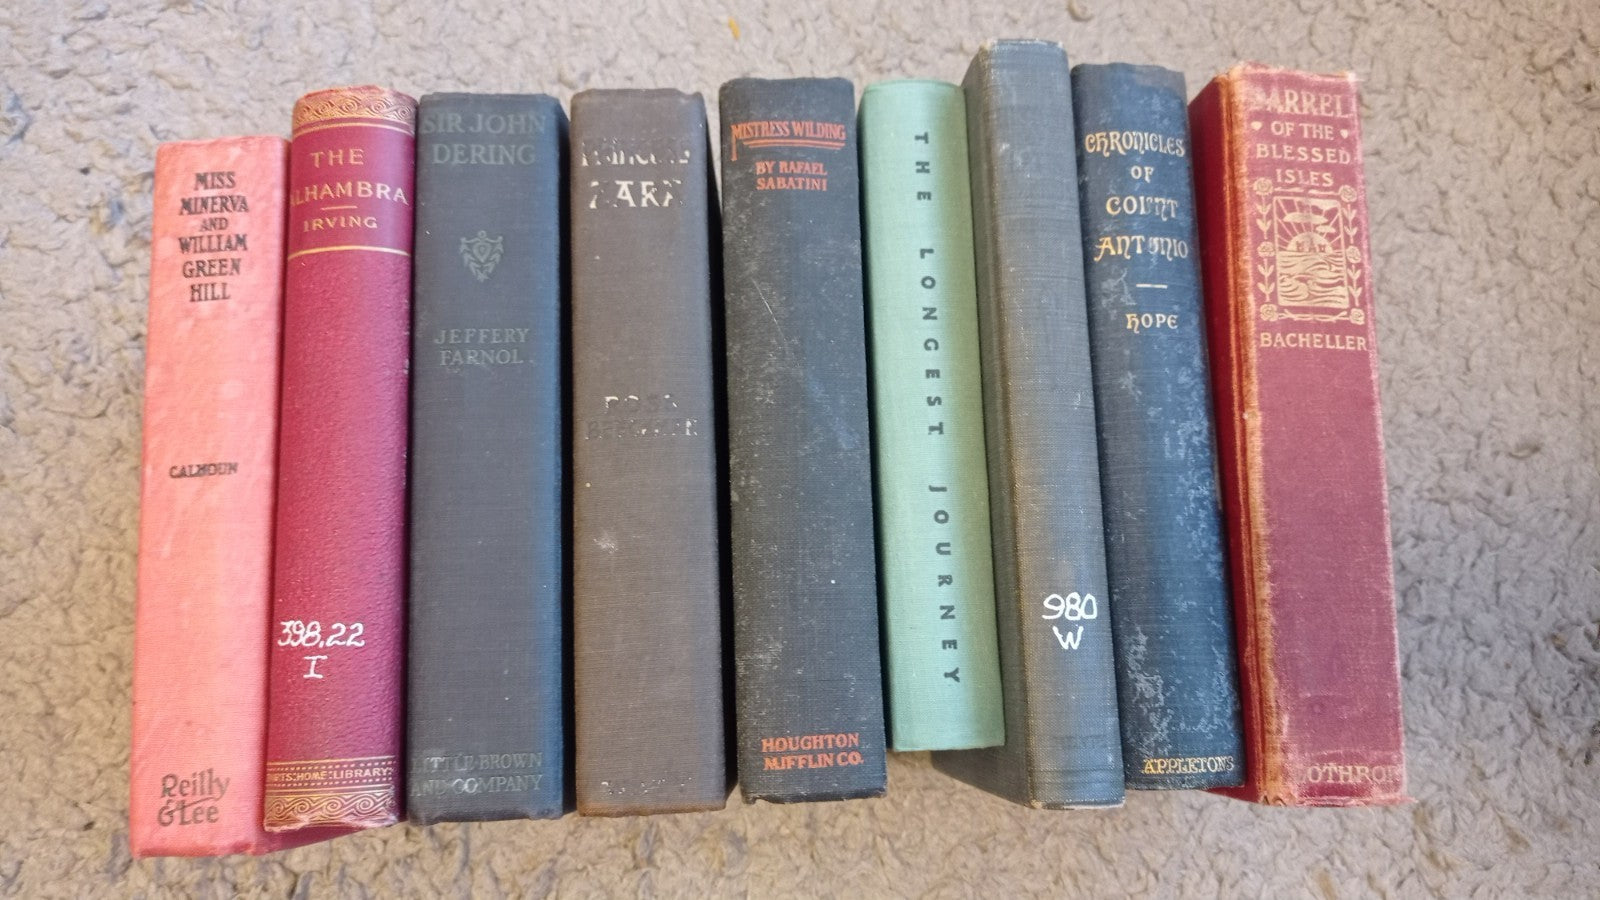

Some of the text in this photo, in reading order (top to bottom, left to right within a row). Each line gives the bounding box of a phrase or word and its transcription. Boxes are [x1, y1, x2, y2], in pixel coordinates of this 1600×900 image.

[421, 111, 547, 135] SIR JOHN
[792, 121, 846, 140] WILDING
[1270, 120, 1335, 141] OF THE
[1085, 131, 1185, 157] CHRONICLES
[1255, 143, 1351, 165] BLESSED
[310, 148, 365, 169] THE
[432, 143, 537, 166] DERING
[755, 161, 828, 176] BY RAFAEL
[1131, 165, 1154, 183] OF
[1275, 168, 1335, 187] ISLES
[193, 171, 237, 191] MISS
[756, 177, 828, 191] SABATINI
[178, 194, 249, 216] MINERVA
[199, 217, 229, 232] AND
[303, 216, 379, 233] IRVING
[178, 233, 248, 254] WILLIAM
[1093, 235, 1189, 262] ANTONIO
[182, 258, 242, 279] GREEN
[190, 282, 231, 302] HILL
[1125, 313, 1179, 334] HOPE
[434, 327, 530, 345] JEFFERY
[1259, 332, 1368, 351] BACHELLER
[439, 348, 525, 366] FARNOL
[914, 131, 961, 684] THE LONGEST JOURNEY
[169, 462, 238, 479] CALHOUN
[1041, 591, 1098, 621] 980
[277, 619, 365, 648] 398.22
[1052, 625, 1084, 650] W
[303, 654, 328, 679] I
[761, 732, 859, 752] HOUGHTON
[478, 752, 543, 770] BROWN
[763, 750, 864, 771] MIFFLIN CO.
[1141, 756, 1235, 774] APPLETONS
[160, 767, 231, 801] Reilly
[296, 771, 327, 781] HOME
[333, 767, 389, 780] LIBRARY
[452, 775, 544, 795] COMPANY
